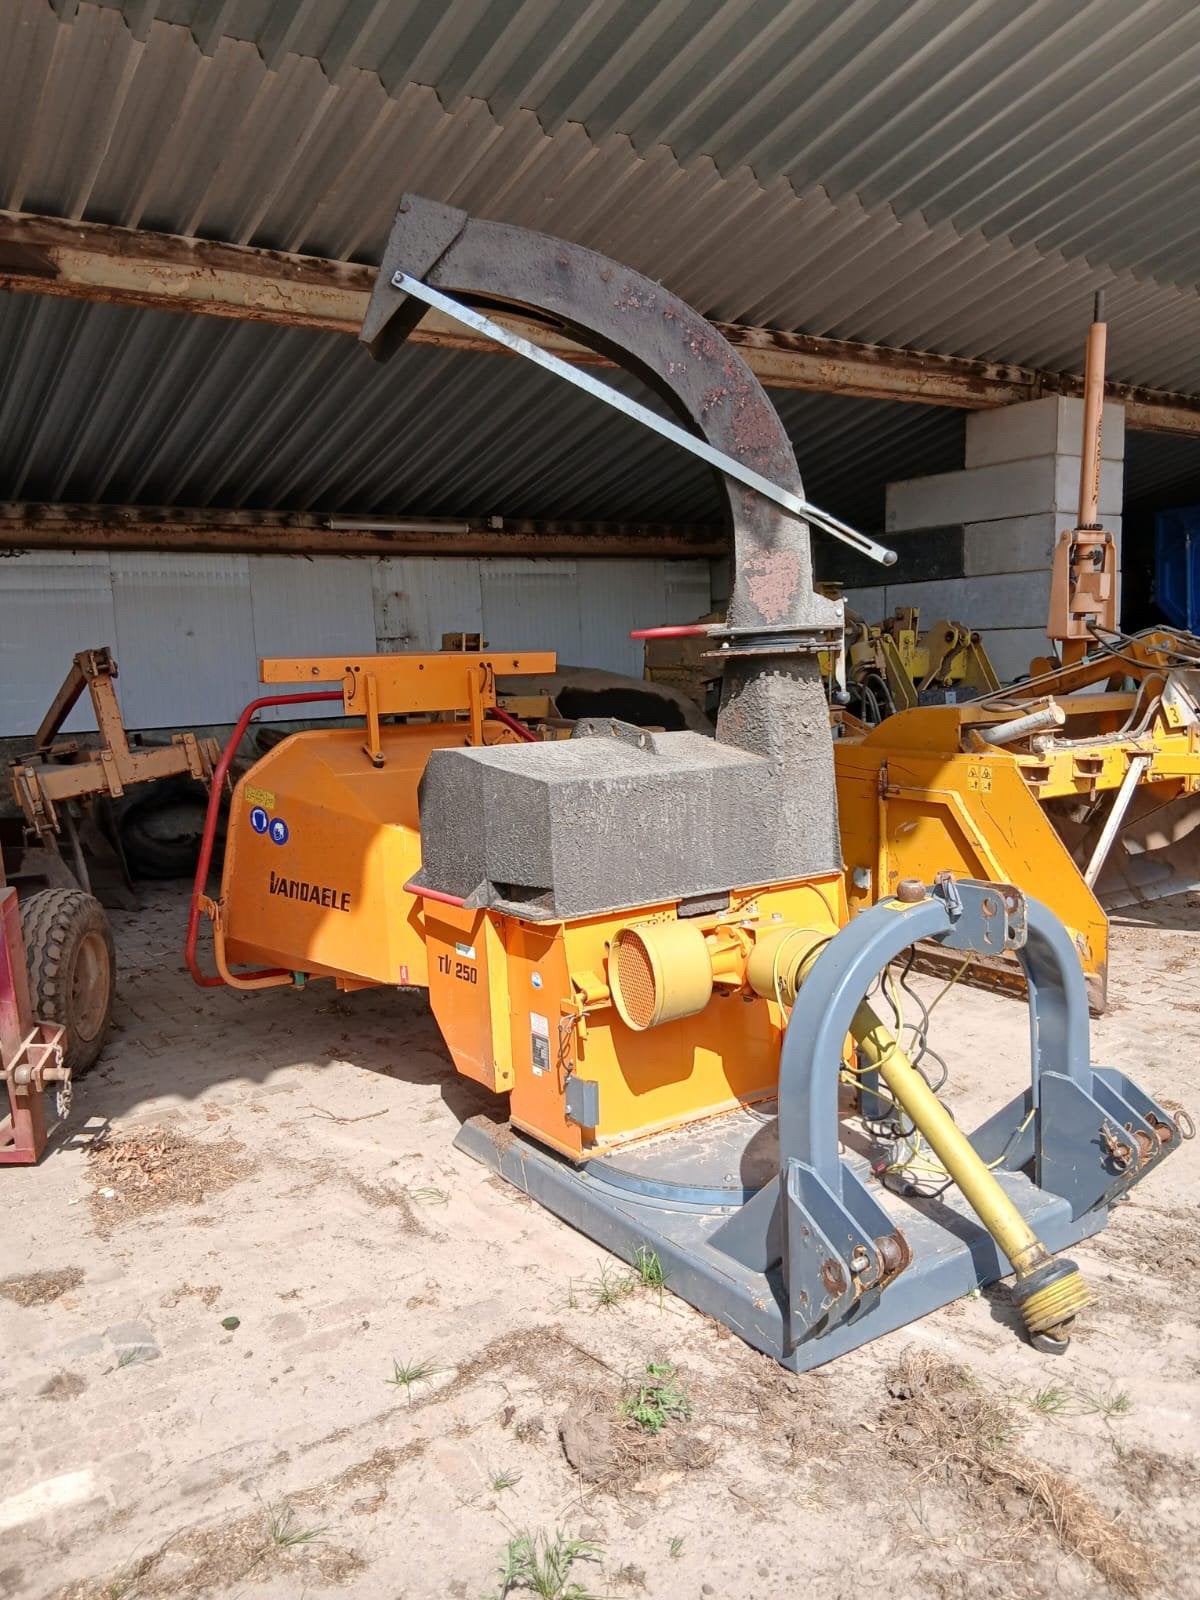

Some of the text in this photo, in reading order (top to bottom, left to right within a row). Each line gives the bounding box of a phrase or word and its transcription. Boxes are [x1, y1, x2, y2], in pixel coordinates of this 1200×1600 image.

[1169, 707, 1179, 724] 3
[269, 870, 351, 912] VANDAELE
[438, 954, 477, 985] TV 250
